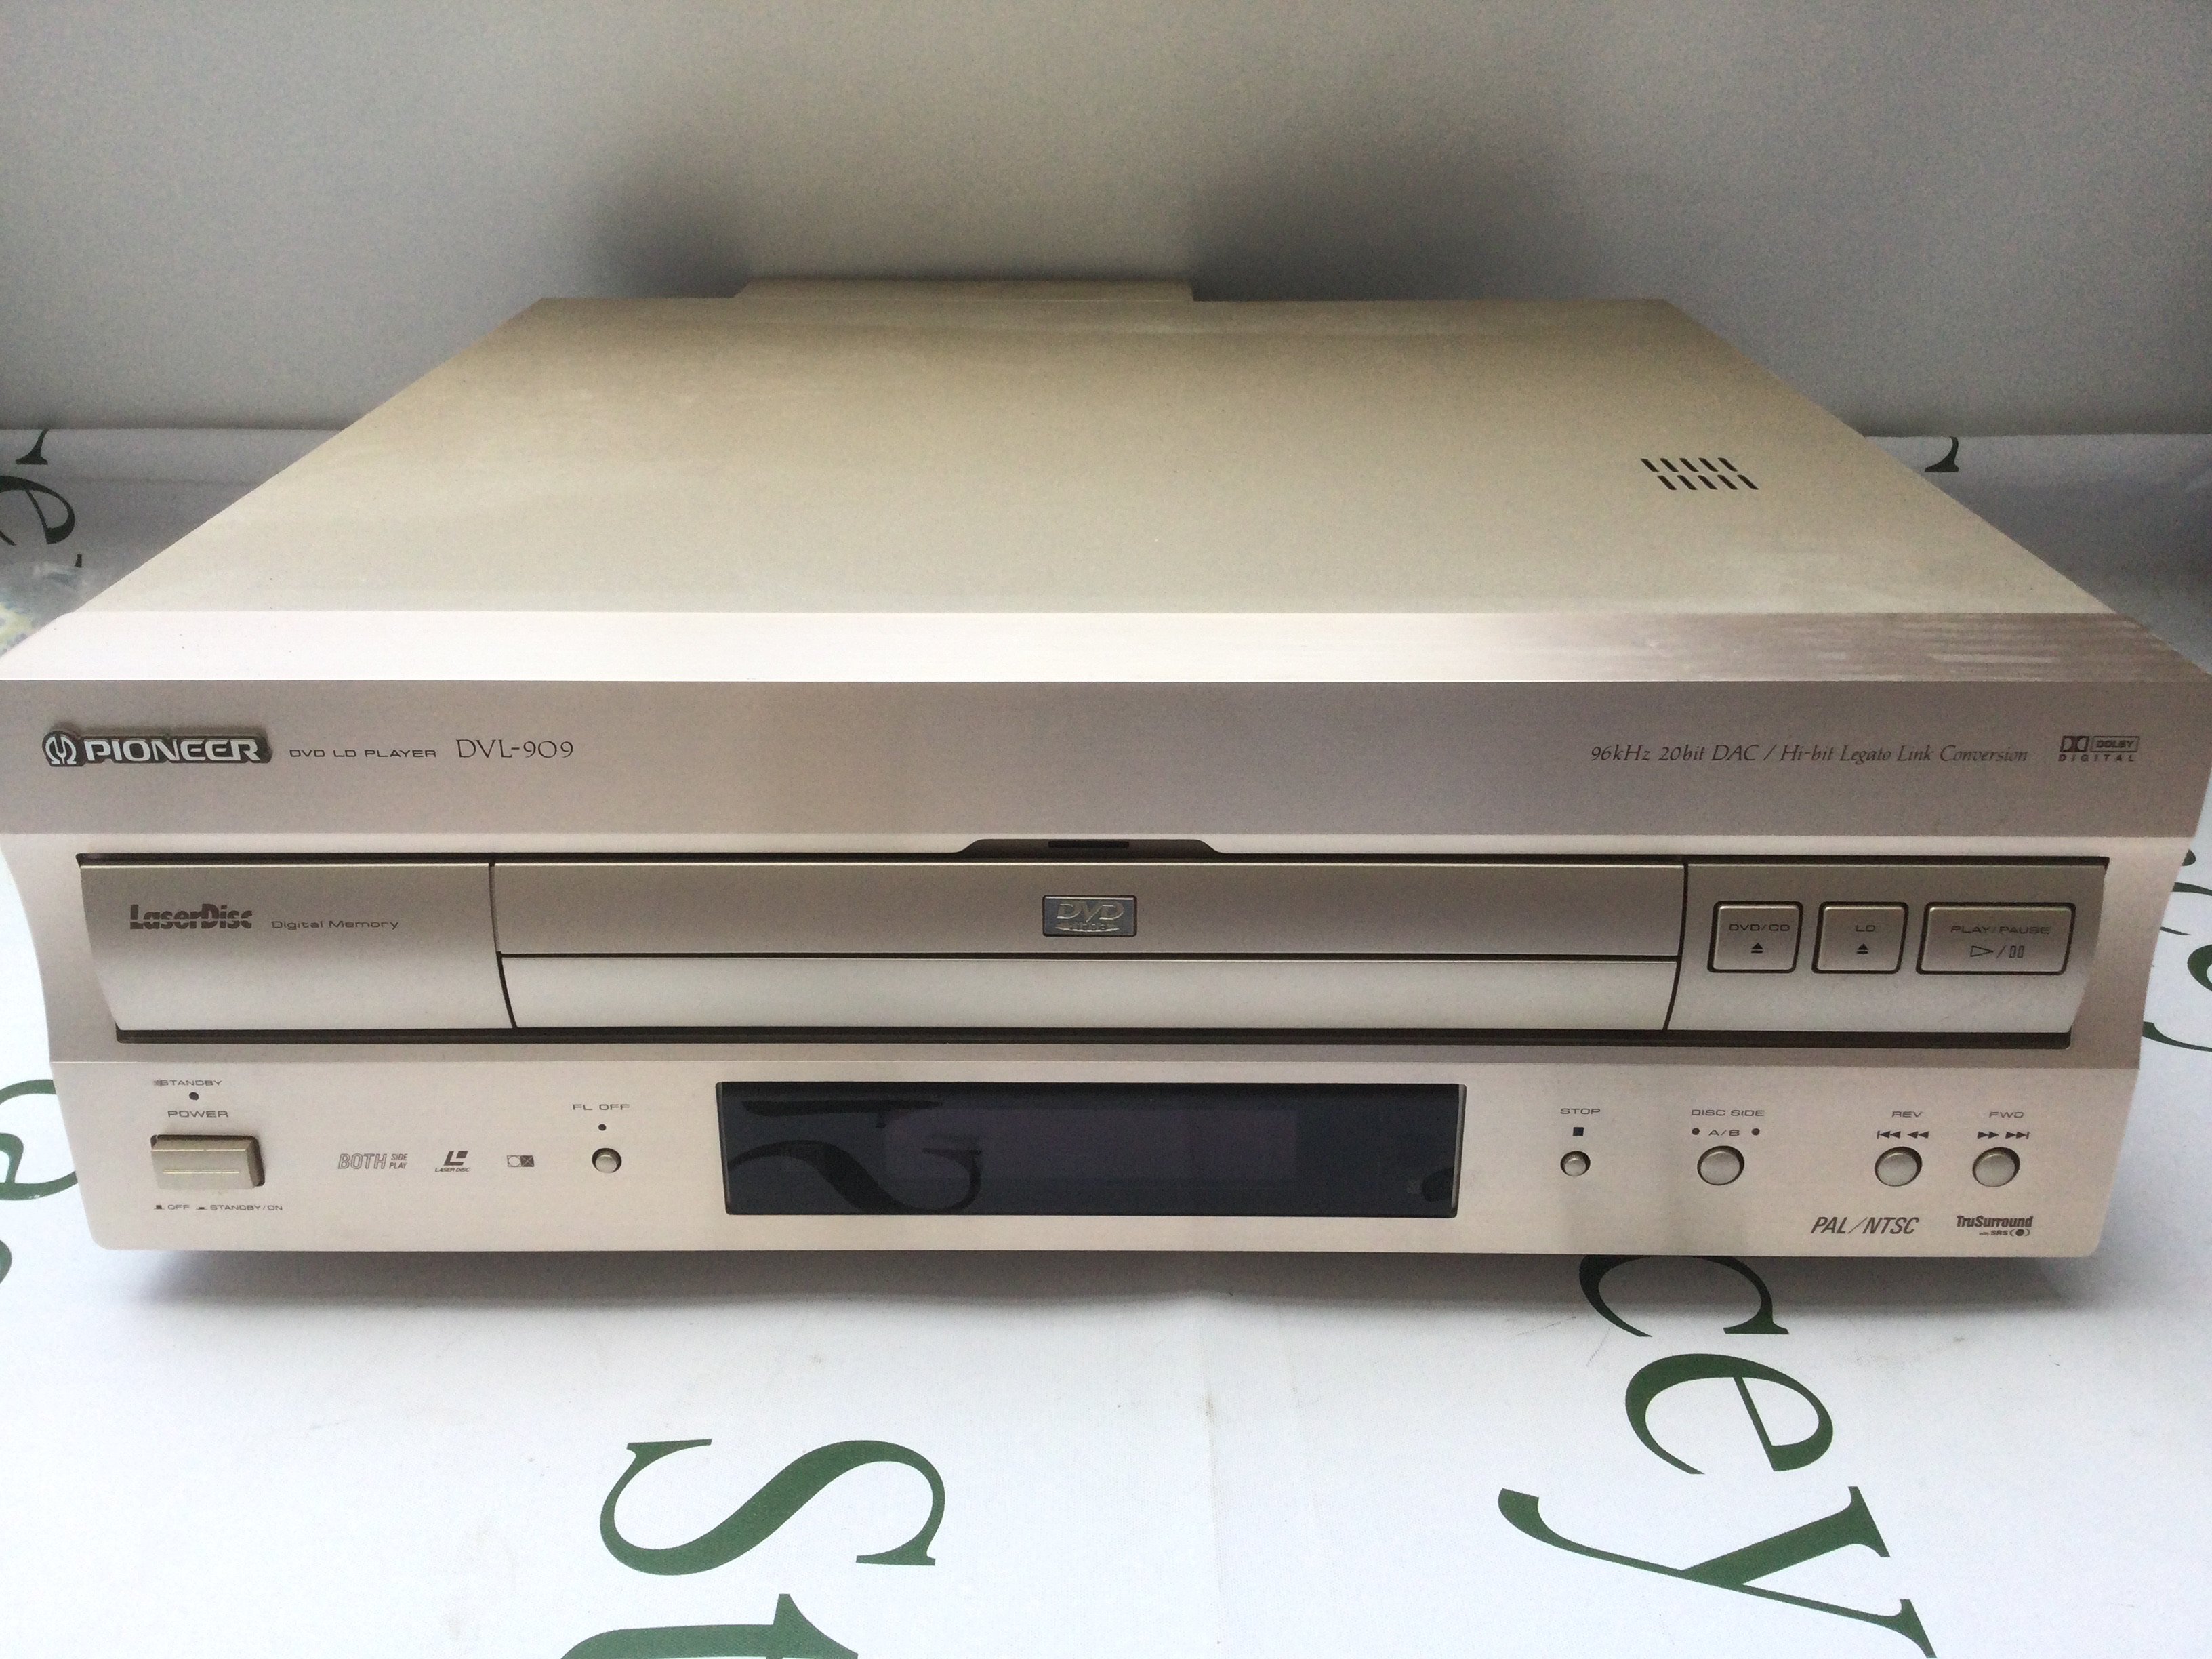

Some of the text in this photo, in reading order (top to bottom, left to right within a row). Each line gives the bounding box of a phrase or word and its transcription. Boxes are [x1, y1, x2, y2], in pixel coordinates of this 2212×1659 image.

[289, 739, 574, 759] DVD LD PLAYER DVL-909
[2095, 740, 2135, 748] DOLBY
[83, 738, 261, 762] PIONEER
[1591, 743, 1651, 762] 96kHz
[1658, 744, 1706, 762] 20bit
[1711, 743, 1760, 761] DAC
[1780, 743, 1834, 762] Hi-bit
[1839, 744, 1892, 766] Legato
[1897, 744, 1932, 762] Link
[1939, 744, 2028, 762] Conversion
[2058, 754, 2135, 762] DIGITAL
[129, 903, 253, 930] LaserDisc
[1055, 901, 1125, 922] DVD
[271, 920, 399, 930] Digital Memory
[1729, 924, 1790, 932] DVD/CD
[1855, 924, 1876, 933] LD
[167, 1110, 229, 1118] POWER
[1691, 1109, 1765, 1117] DISC SIDE
[1708, 1129, 1740, 1137] A/B
[338, 1153, 388, 1170] BOTH
[1810, 1216, 1920, 1235] PAL/NTSC
[1956, 1215, 2034, 1228] TruSurround
